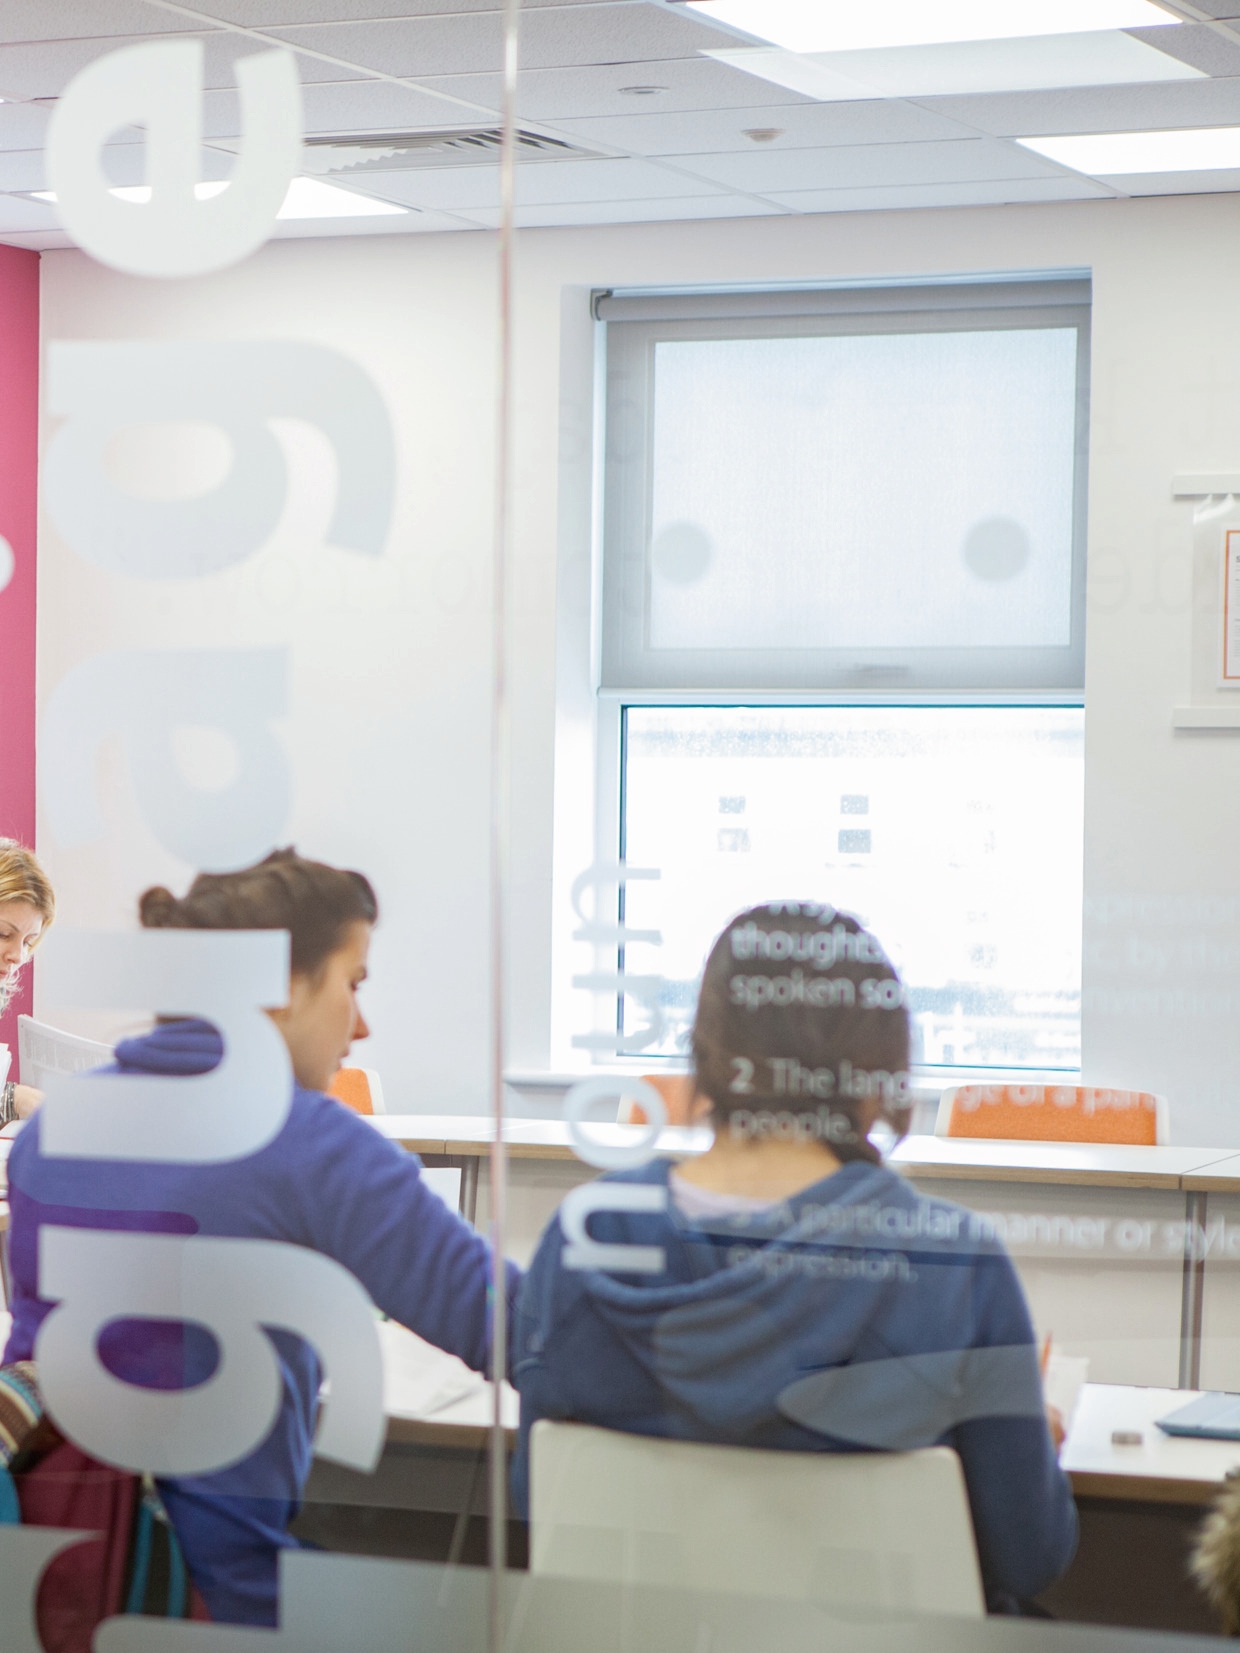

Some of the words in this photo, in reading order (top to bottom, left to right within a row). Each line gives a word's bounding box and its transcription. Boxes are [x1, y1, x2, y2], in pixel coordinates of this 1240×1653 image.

[730, 967, 855, 1013] spoken
[730, 1057, 754, 1094] 2
[765, 1057, 835, 1098] The
[730, 1104, 858, 1146] people.
[967, 1211, 1106, 1249] manner
[1116, 1218, 1155, 1251] or
